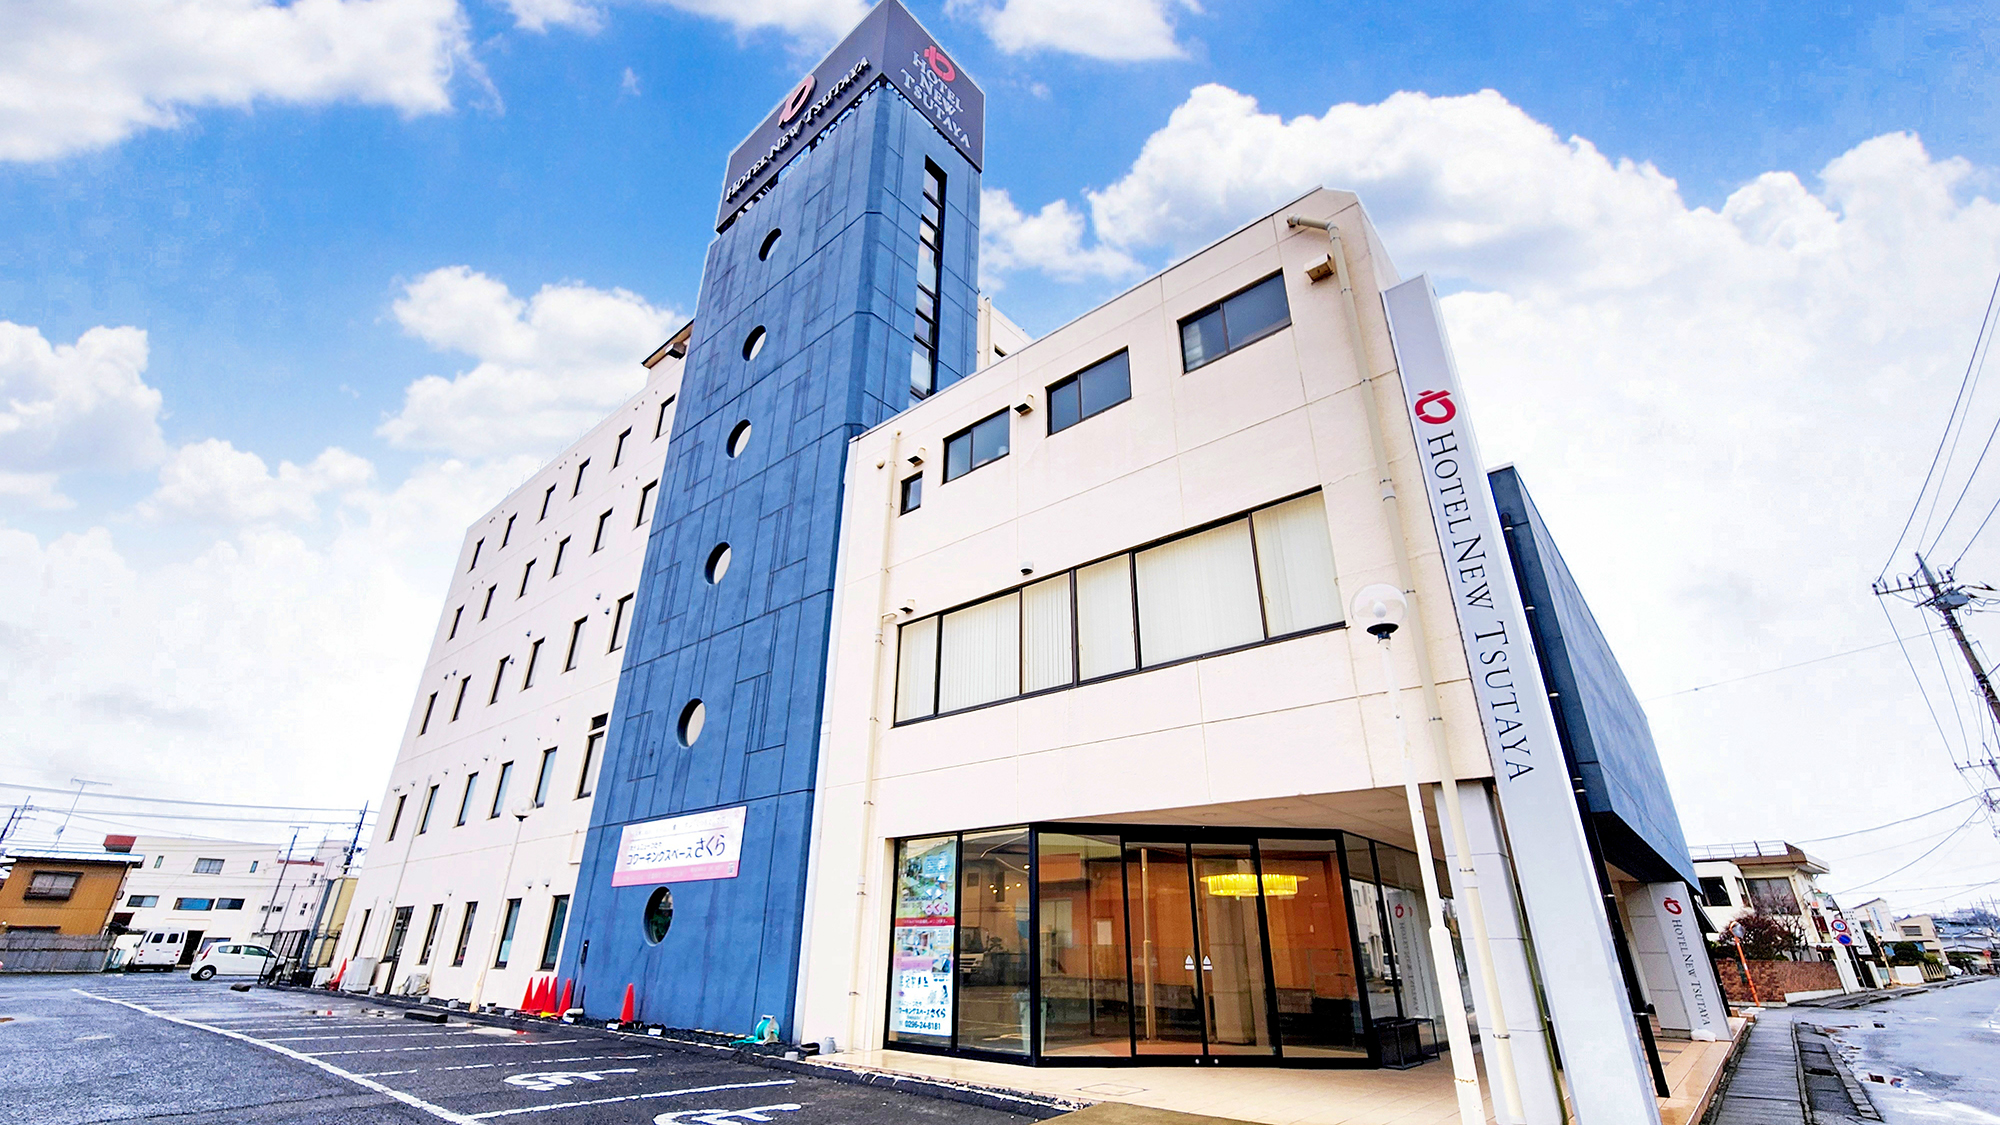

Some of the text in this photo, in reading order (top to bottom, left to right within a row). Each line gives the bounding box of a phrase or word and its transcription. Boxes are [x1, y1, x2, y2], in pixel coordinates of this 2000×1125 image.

[725, 56, 871, 202] HOTEL NEW TSUTAYA
[900, 68, 971, 149] TSUTAYA
[912, 51, 964, 113] HOTEL
[919, 69, 956, 116] NEW
[1427, 429, 1535, 783] HOTEL NEW TSUTAYA
[1672, 919, 1711, 1026] HOTEL NEW TSUTAYA
